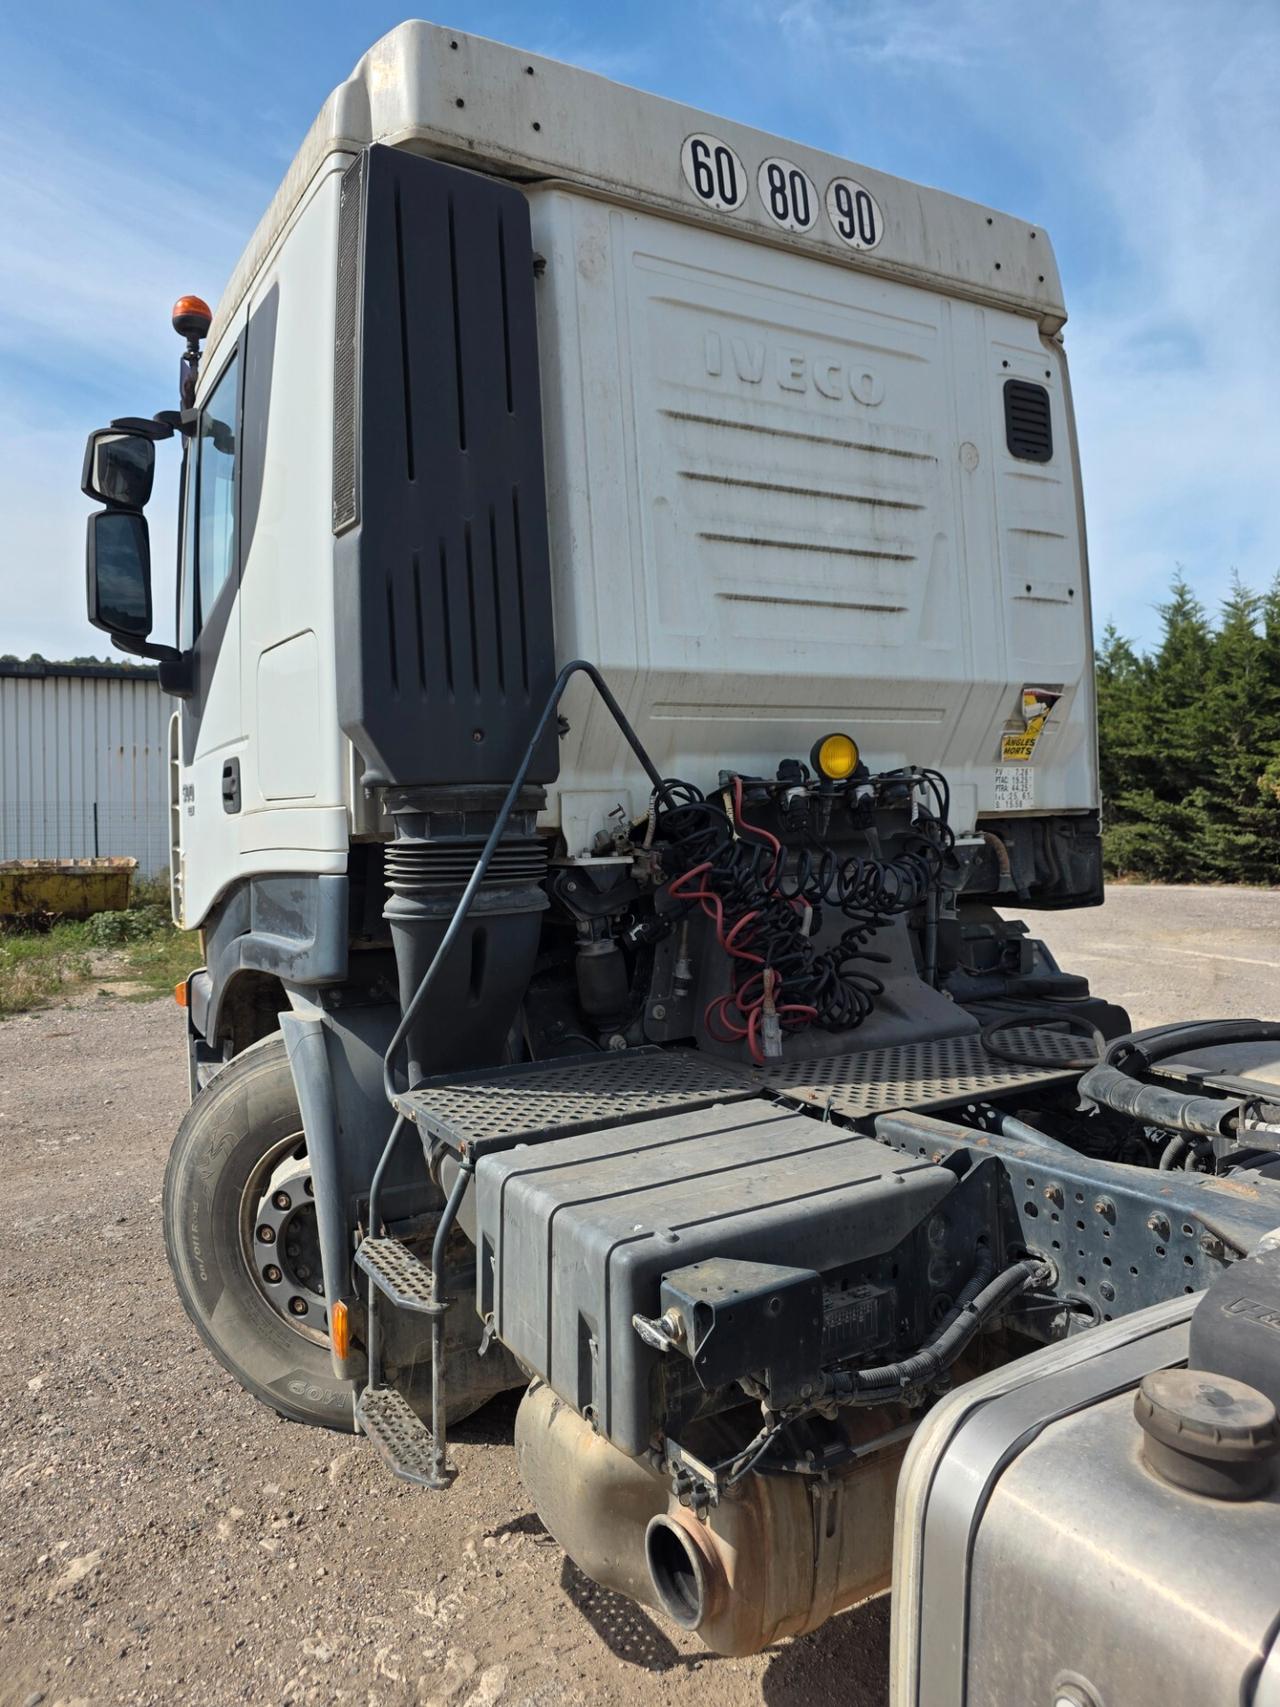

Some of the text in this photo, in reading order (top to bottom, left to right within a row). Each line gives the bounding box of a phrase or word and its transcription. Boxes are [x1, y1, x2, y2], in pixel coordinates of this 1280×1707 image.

[690, 138, 738, 206] 60
[767, 163, 810, 227] 80
[834, 182, 876, 246] 90
[704, 330, 886, 407] IVECO
[1004, 747, 1032, 755] MORTS
[1005, 738, 1035, 747] ANGLES
